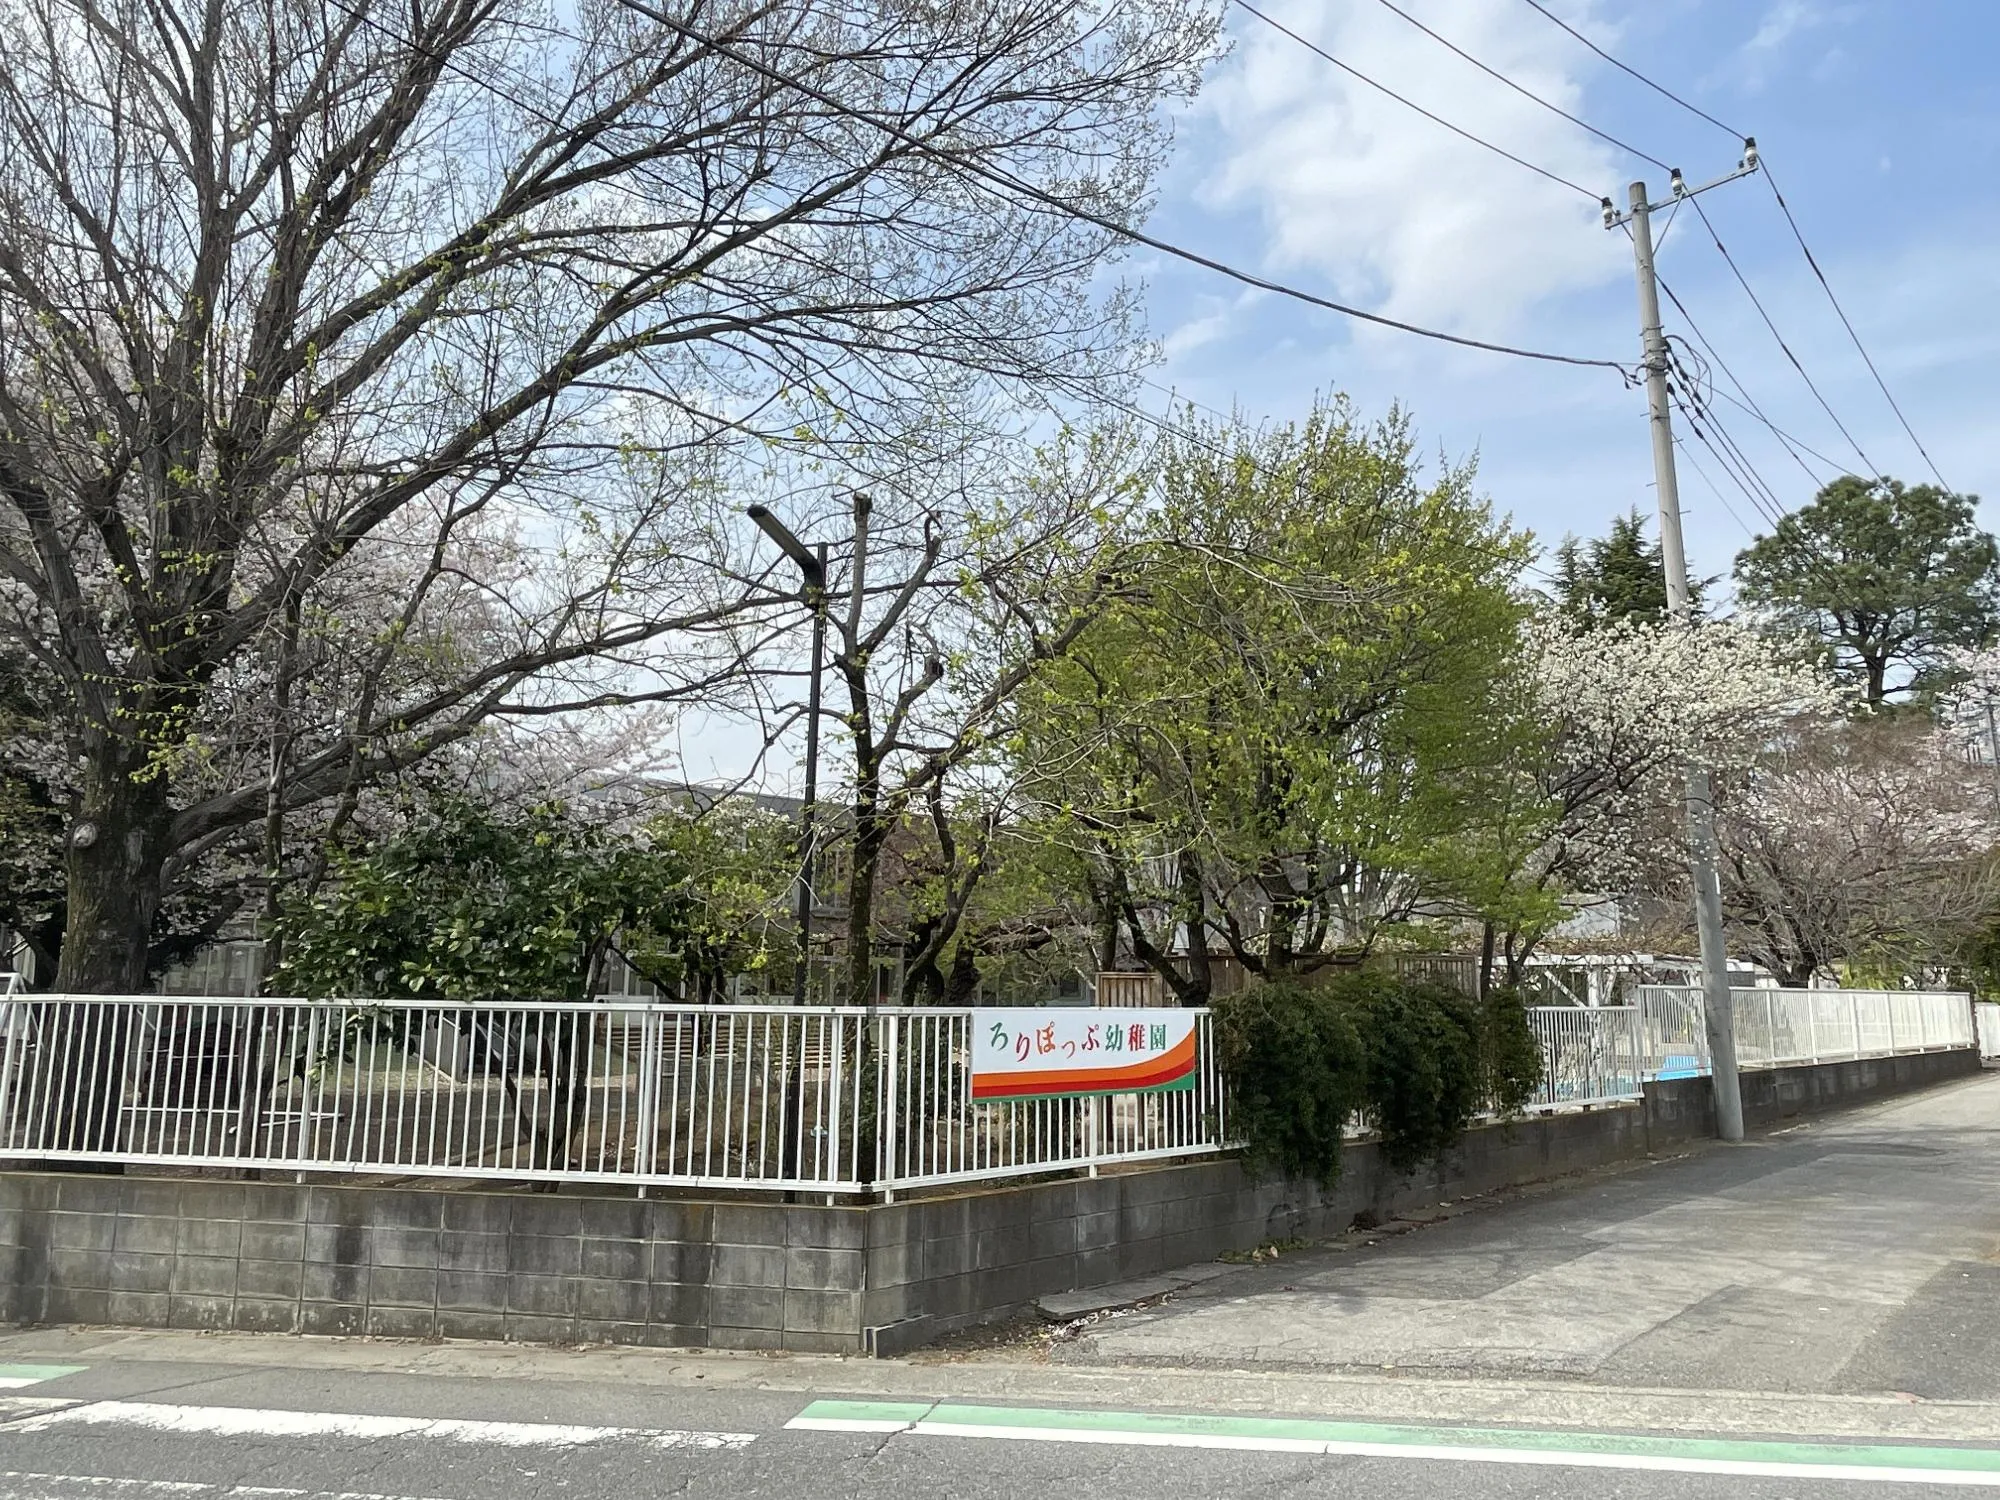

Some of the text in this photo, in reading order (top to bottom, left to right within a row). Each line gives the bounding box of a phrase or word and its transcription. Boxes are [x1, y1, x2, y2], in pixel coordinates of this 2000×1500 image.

[990, 1021, 1166, 1062] ろりぽっぷ幼稚園
